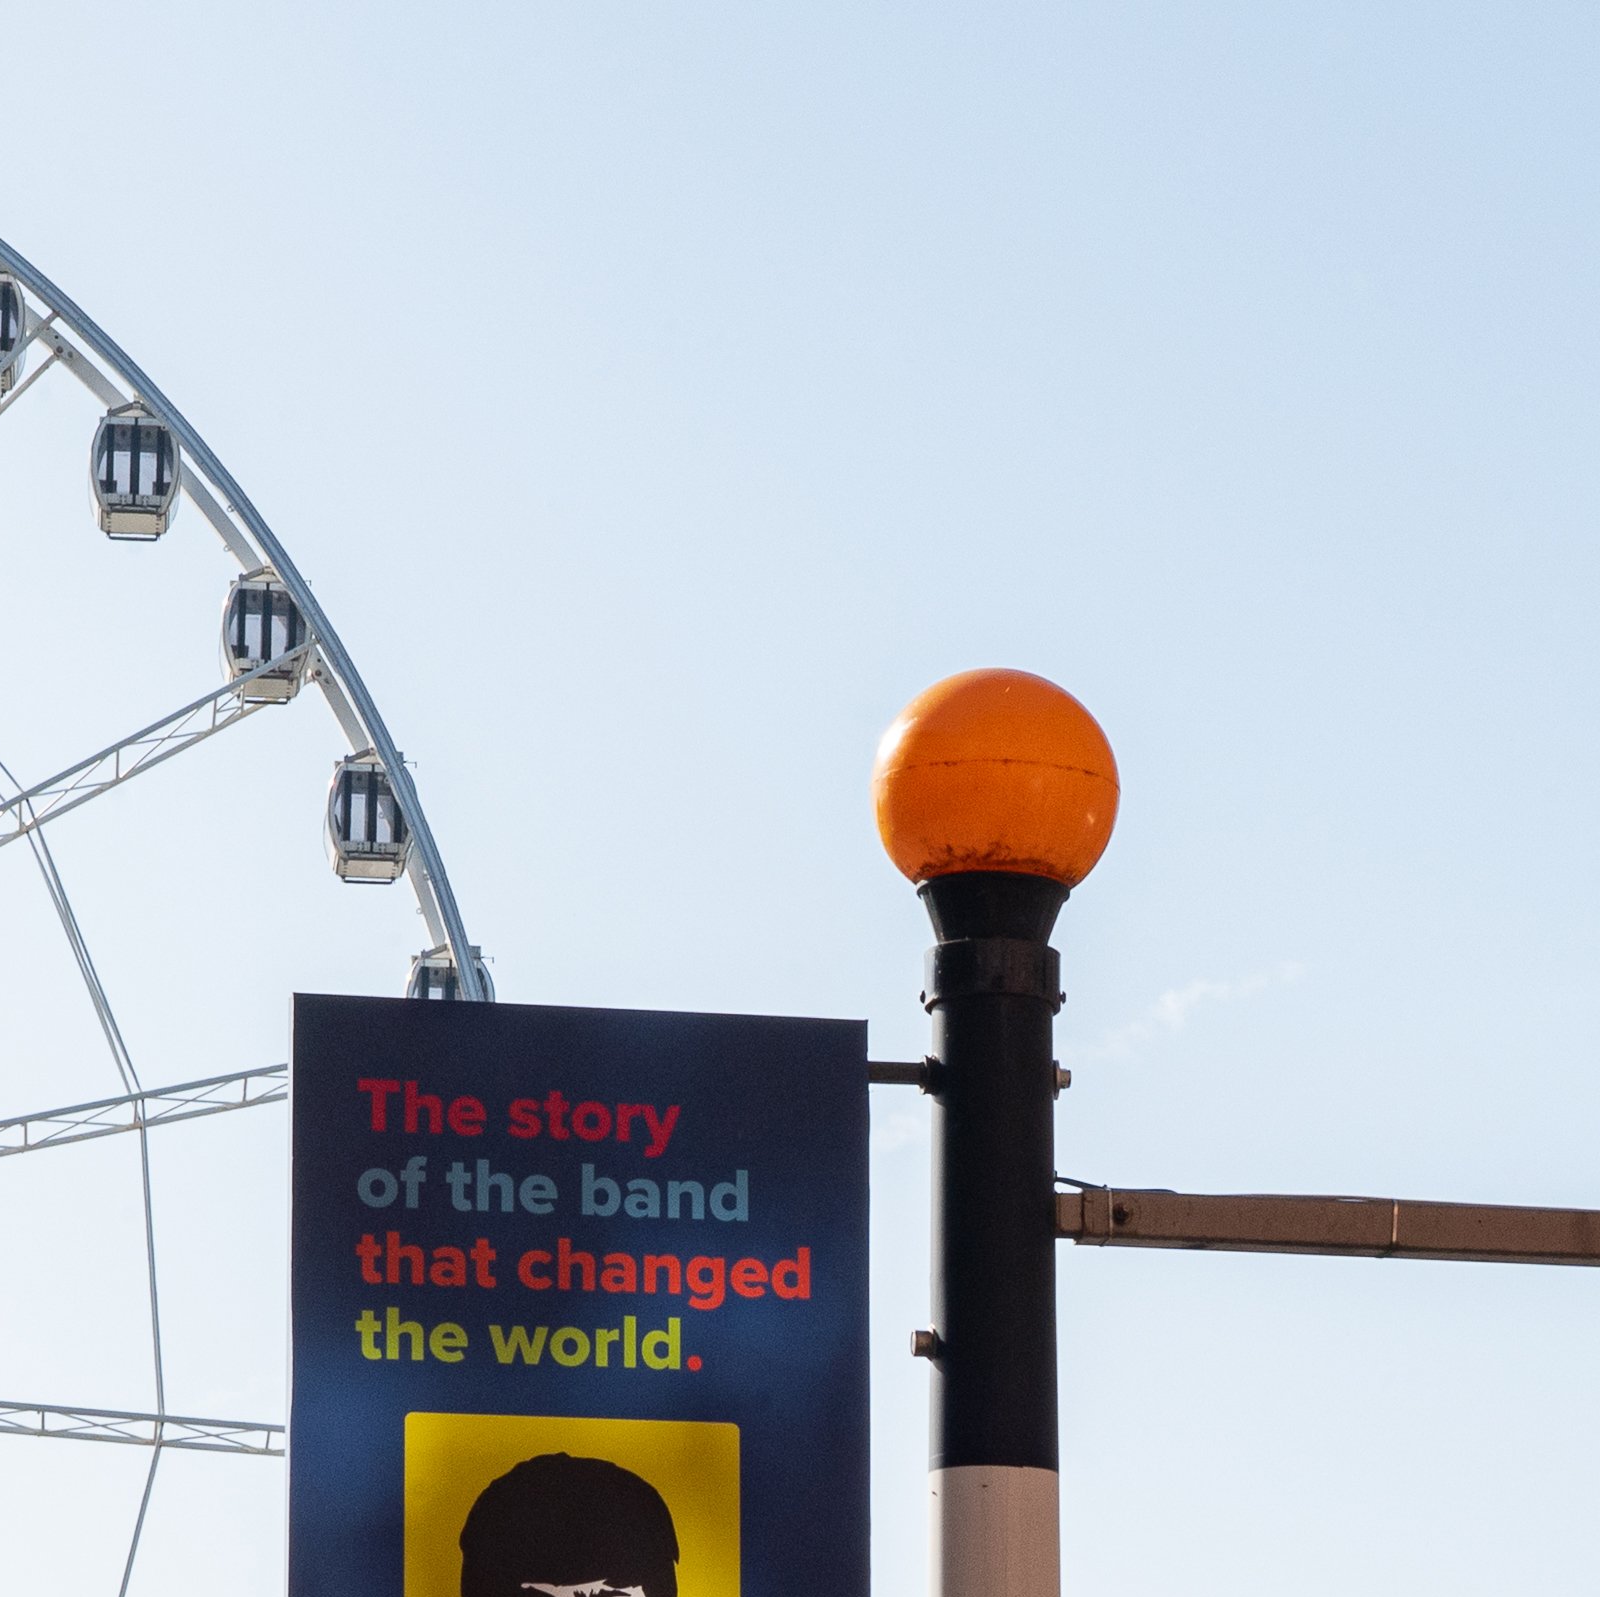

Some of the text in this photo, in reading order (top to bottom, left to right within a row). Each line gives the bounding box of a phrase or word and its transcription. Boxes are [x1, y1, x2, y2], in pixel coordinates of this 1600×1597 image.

[357, 1078, 681, 1157] The story
[357, 1156, 749, 1222] of the band
[356, 1231, 812, 1311] that changed
[355, 1307, 703, 1372] the world.
